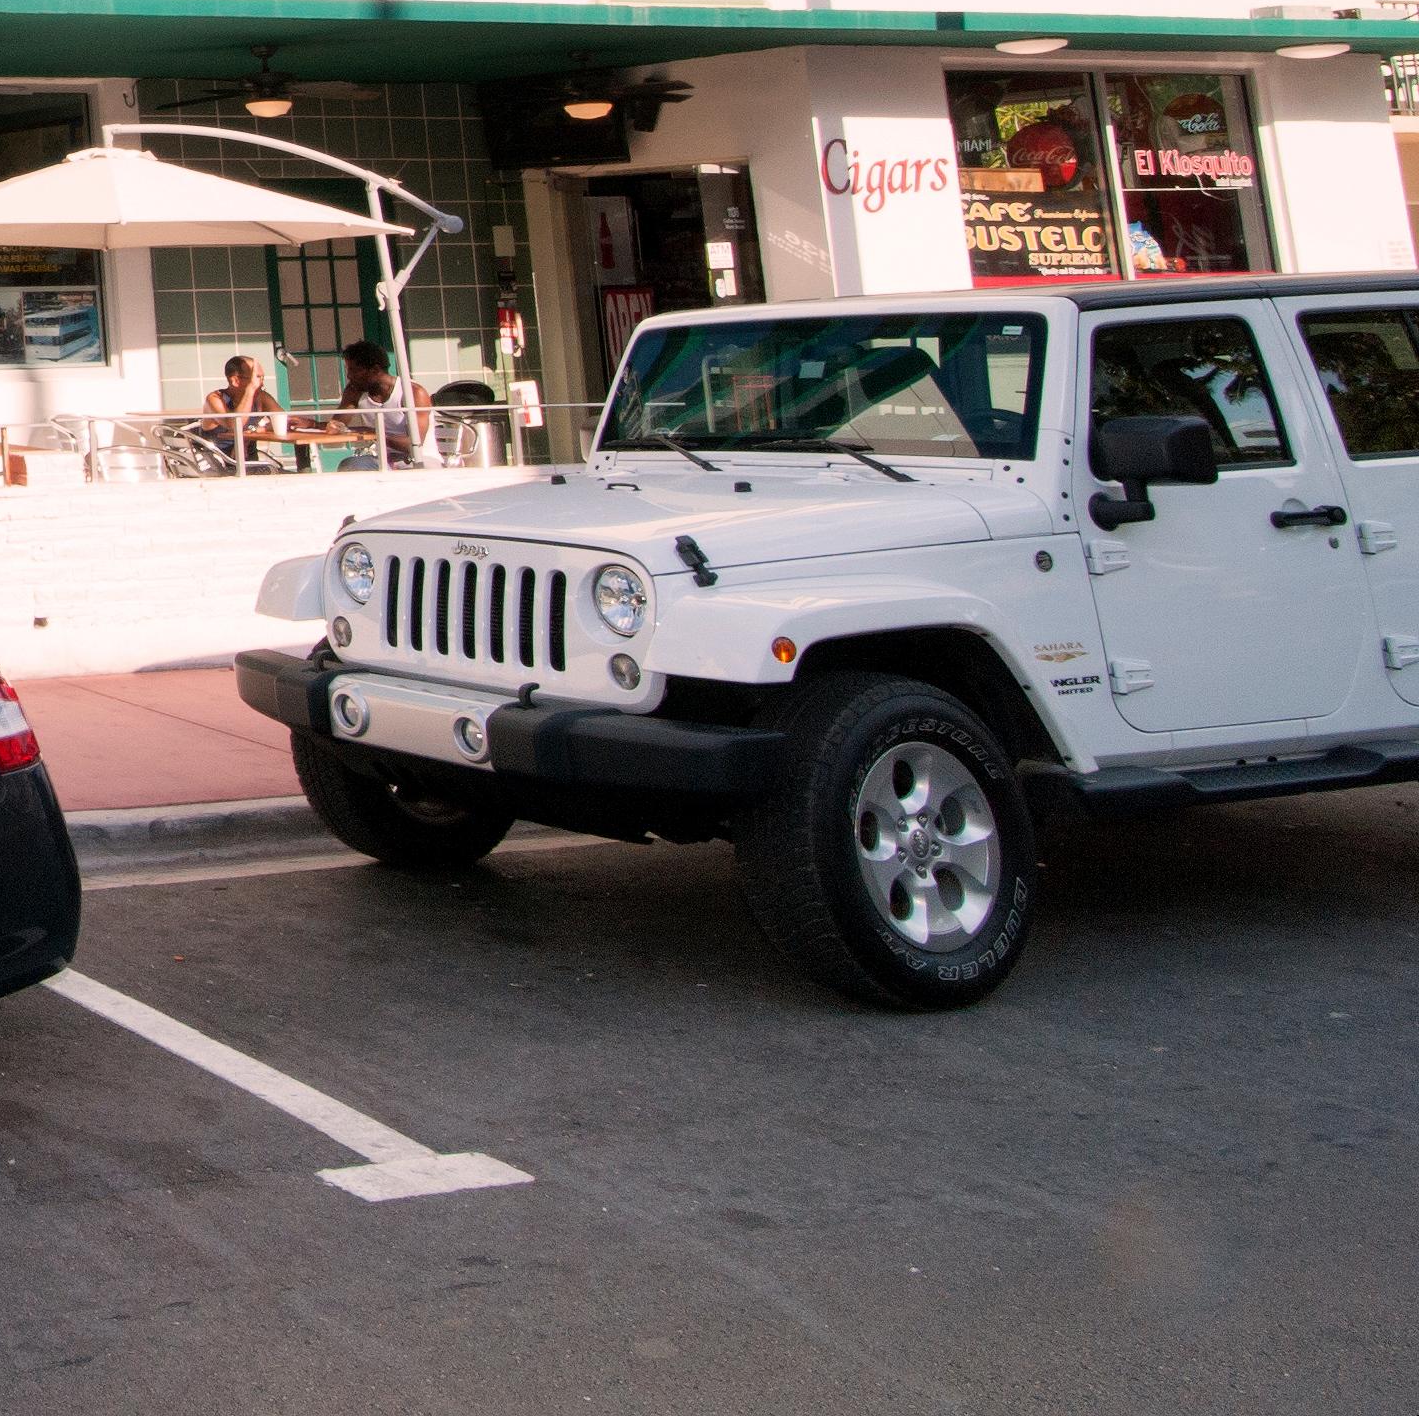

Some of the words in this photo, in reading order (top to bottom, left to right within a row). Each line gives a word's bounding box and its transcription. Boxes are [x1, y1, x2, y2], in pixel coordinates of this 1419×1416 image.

[822, 138, 948, 213] Cigars
[1134, 149, 1156, 176] El
[1158, 149, 1253, 180] Kiosquito
[453, 540, 489, 560] Jeep
[1033, 641, 1084, 652] SAHARA
